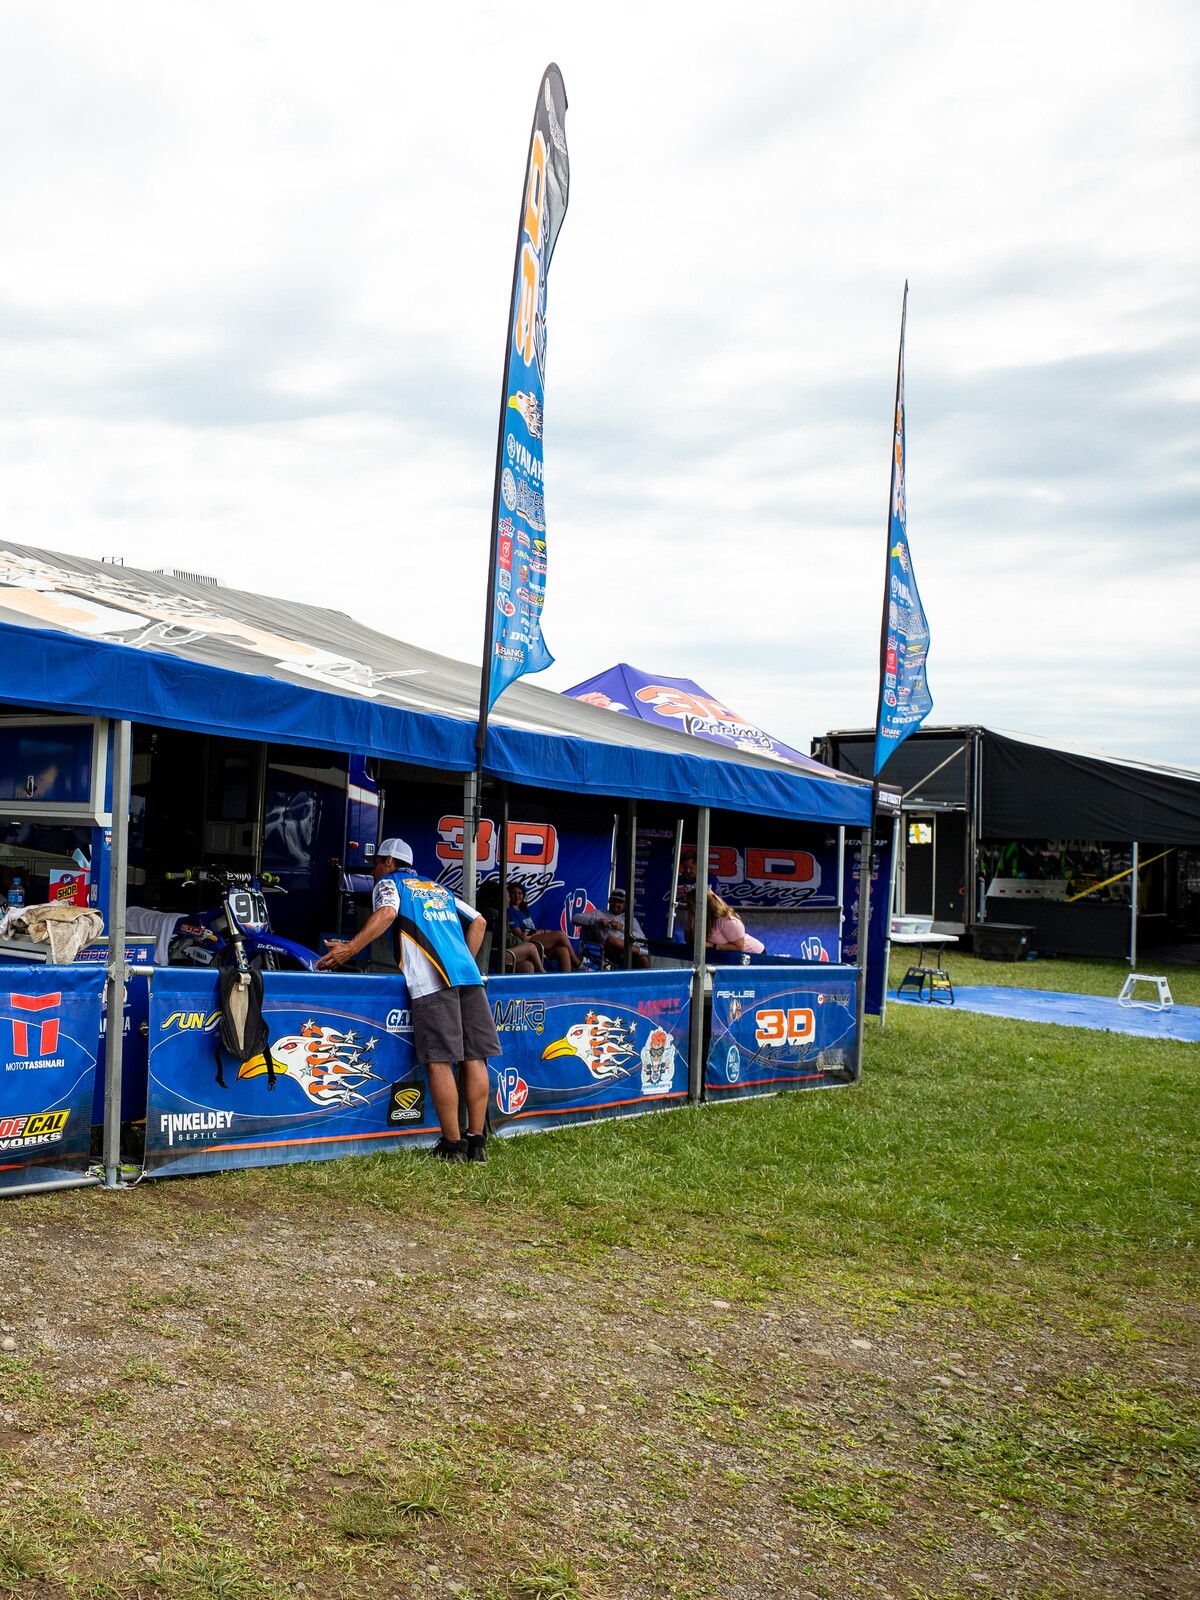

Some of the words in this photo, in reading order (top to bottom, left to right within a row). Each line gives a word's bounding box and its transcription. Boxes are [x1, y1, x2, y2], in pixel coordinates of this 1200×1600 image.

[436, 815, 558, 869] 3D
[58, 884, 77, 899] SHOP
[494, 999, 546, 1032] Mika
[756, 1008, 814, 1044] 3D
[5, 1058, 65, 1072] MOTOTASSINARI
[498, 1068, 519, 1114] VP
[160, 1111, 234, 1146] FINKELDEY
[178, 1132, 218, 1142] SEPTIC
